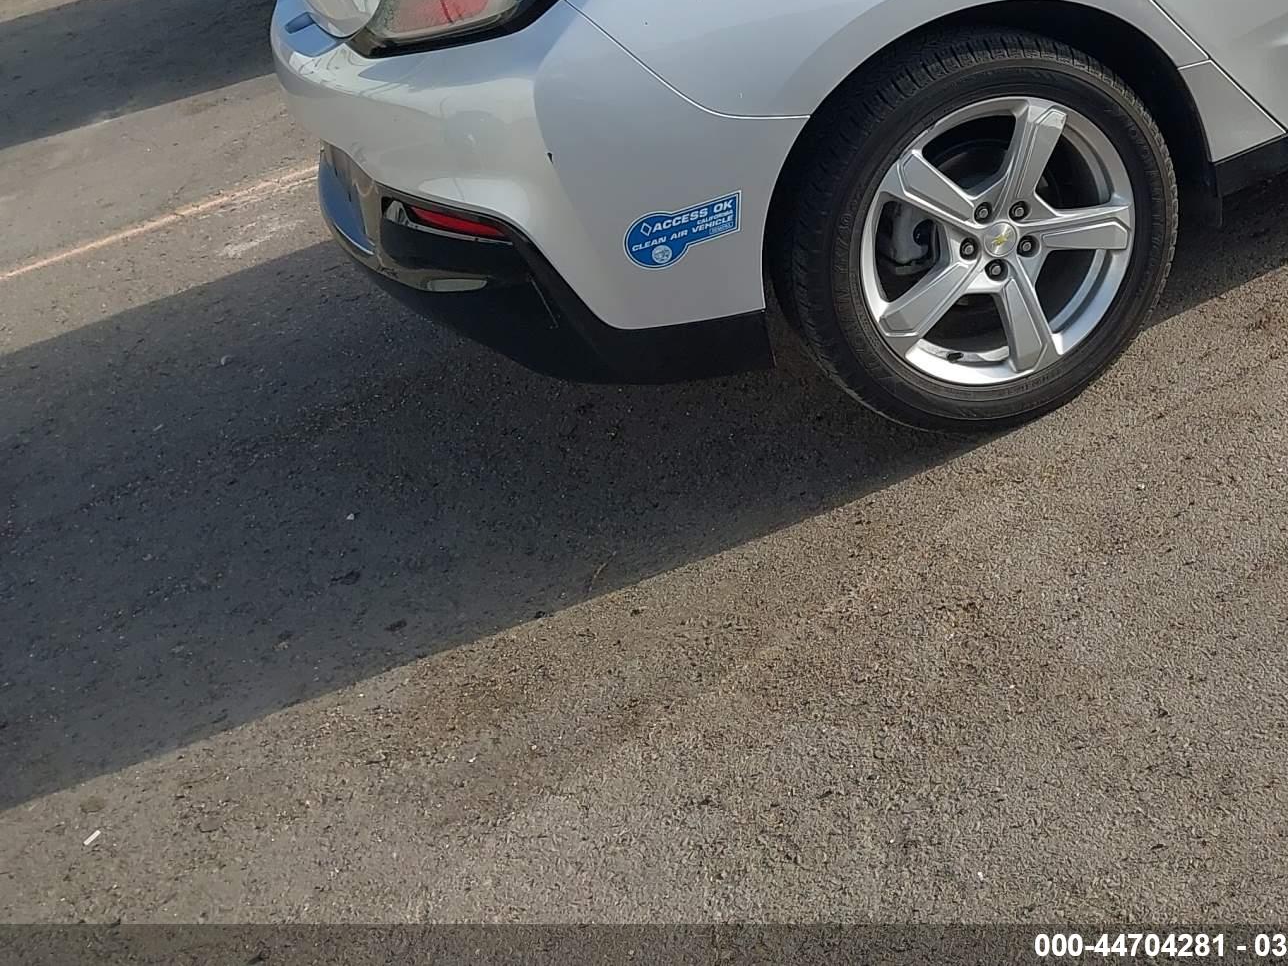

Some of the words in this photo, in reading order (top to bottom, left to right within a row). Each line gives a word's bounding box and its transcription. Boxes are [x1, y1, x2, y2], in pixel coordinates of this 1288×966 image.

[631, 236, 667, 252] CLEAN
[670, 229, 688, 241] AIR
[691, 214, 734, 234] VEHICLE
[652, 207, 708, 233] ACCESS
[713, 199, 733, 214] OK
